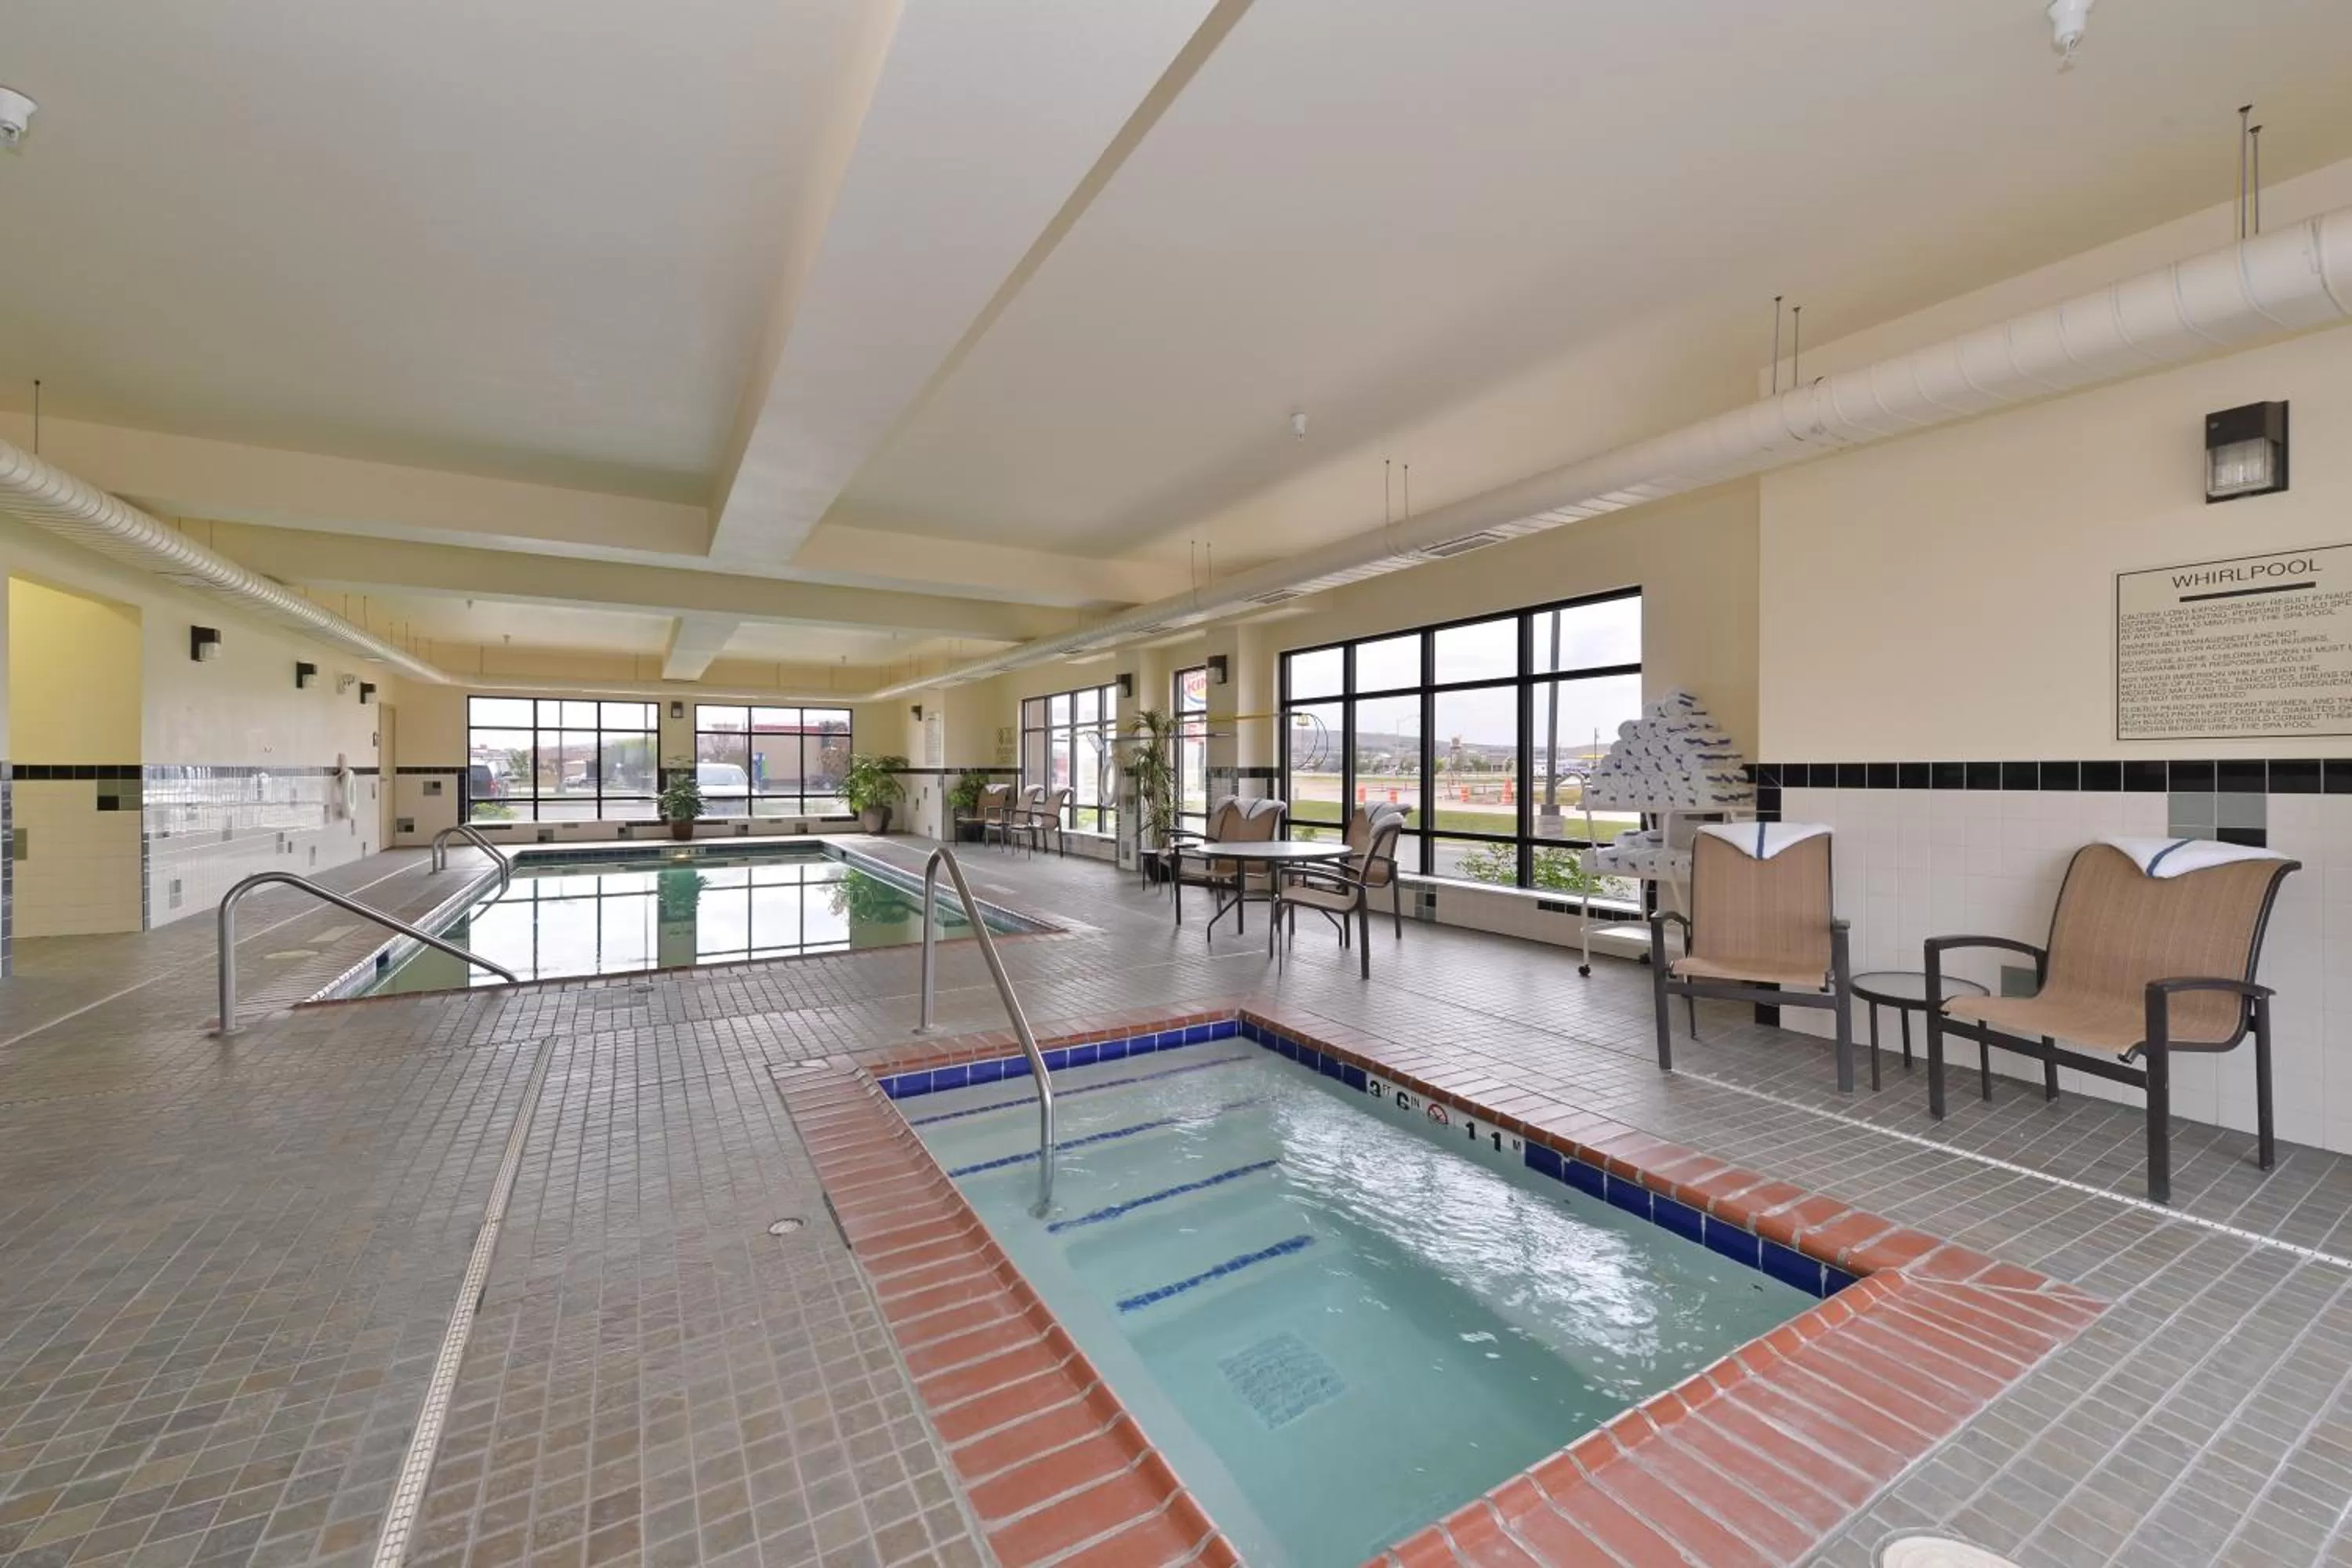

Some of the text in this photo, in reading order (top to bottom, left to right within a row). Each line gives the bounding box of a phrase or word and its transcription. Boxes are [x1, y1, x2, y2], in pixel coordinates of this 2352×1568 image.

[2172, 558, 2323, 589] WHIRLPOOL
[2284, 601, 2327, 612] SHOULD
[2284, 611, 2302, 619] SPA
[2306, 608, 2336, 617] POOL
[2277, 629, 2298, 637] NOT
[2314, 644, 2344, 653] MUST
[2299, 664, 2320, 673] THE
[1369, 1080, 1381, 1098] 3
[1396, 1091, 1410, 1110] 6
